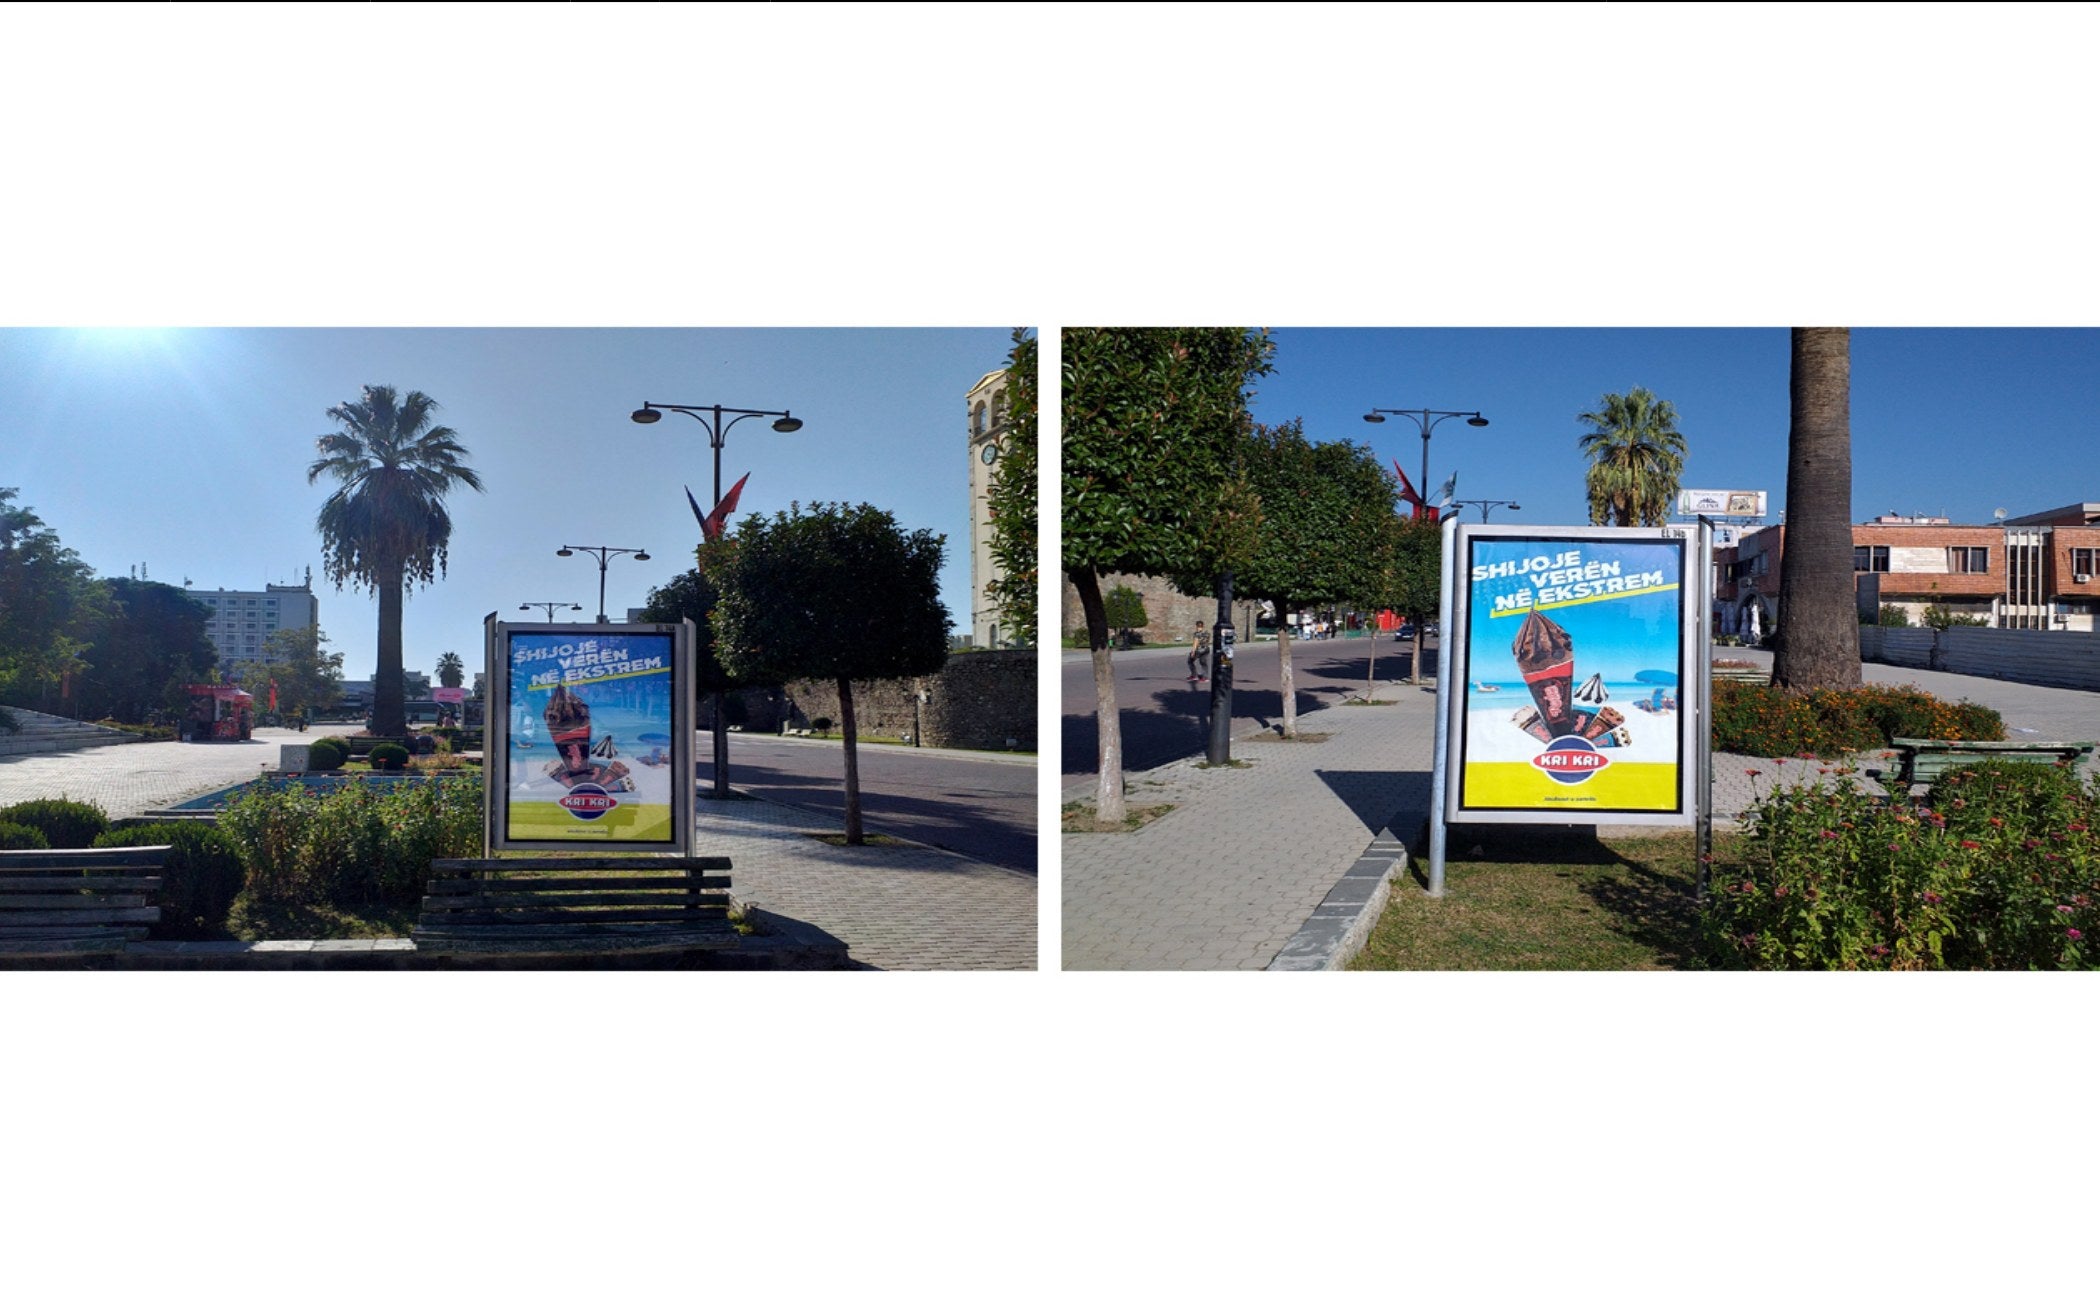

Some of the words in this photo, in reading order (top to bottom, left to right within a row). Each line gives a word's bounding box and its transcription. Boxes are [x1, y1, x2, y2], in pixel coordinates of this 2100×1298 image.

[1472, 551, 1581, 581] SHIJOJE
[1530, 560, 1621, 588] VERËN
[1494, 588, 1533, 612] NË
[1538, 570, 1664, 603] EKSTREM
[513, 640, 598, 665] SHIJOJE
[557, 648, 629, 669] VERËN
[531, 669, 560, 686] NË
[565, 656, 662, 682] EKSTREM
[1541, 755, 1568, 766] KRI
[1573, 755, 1600, 766] KRI
[565, 797, 585, 806] KRI
[589, 797, 611, 807] KRI
